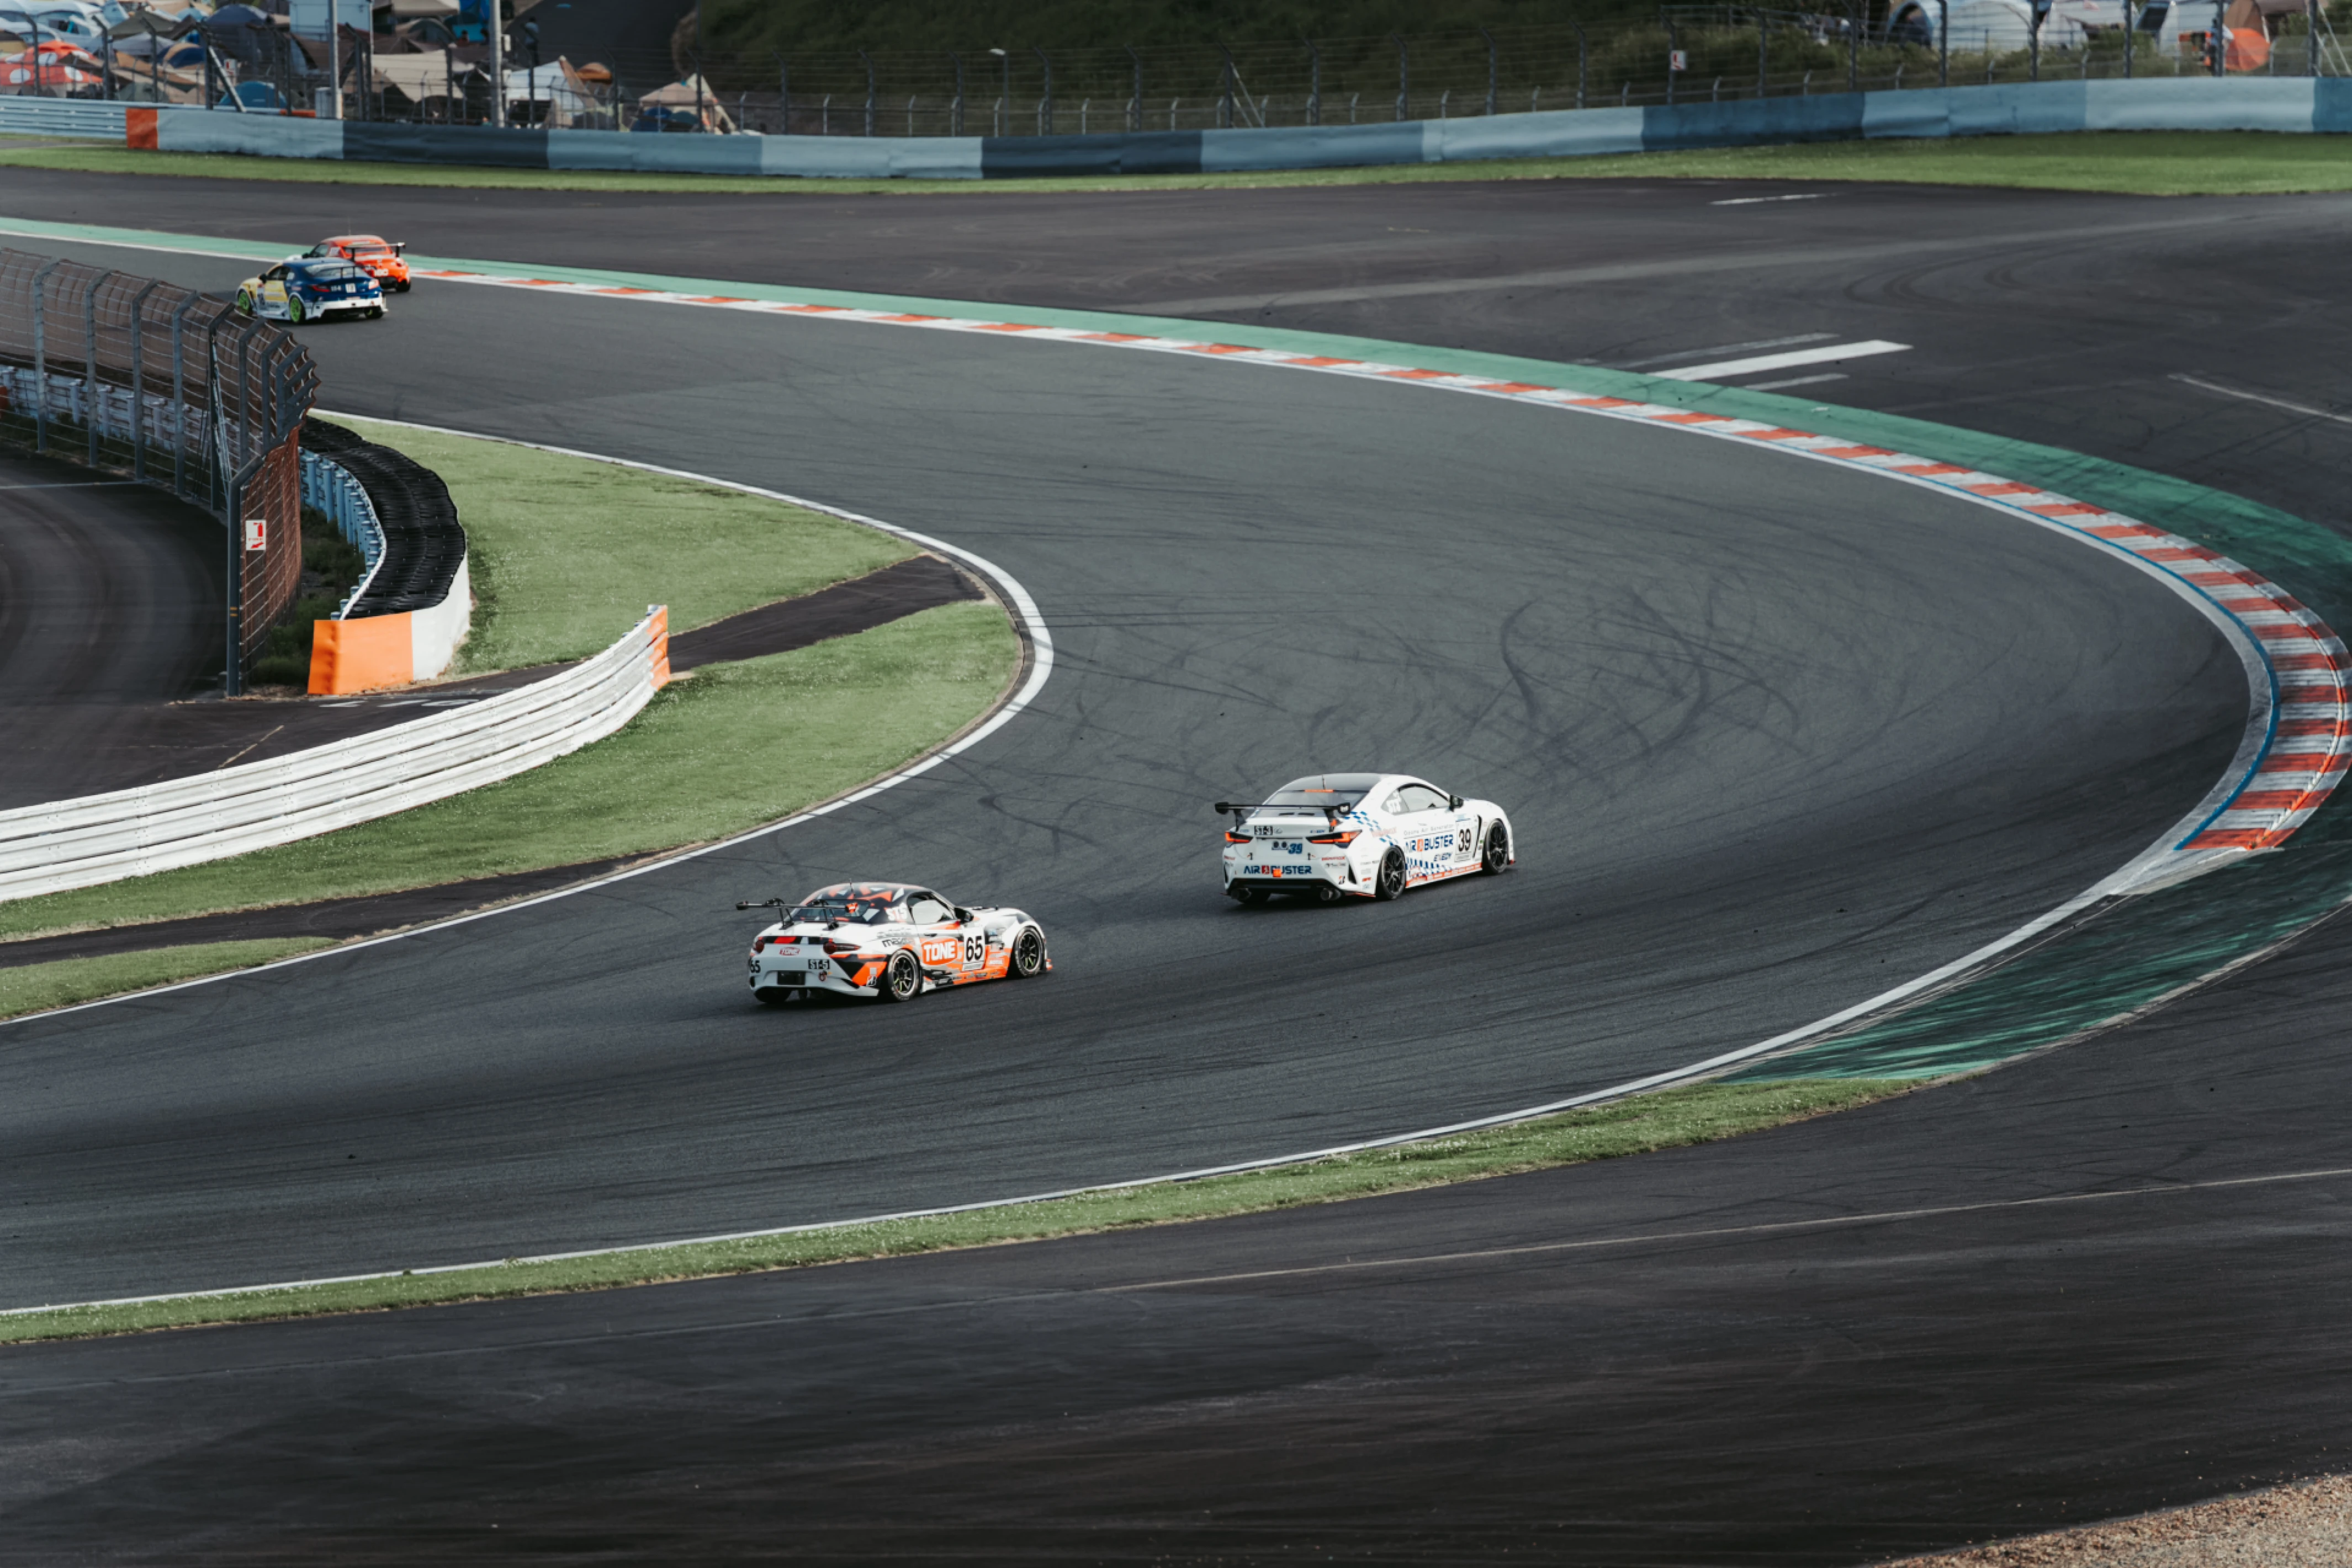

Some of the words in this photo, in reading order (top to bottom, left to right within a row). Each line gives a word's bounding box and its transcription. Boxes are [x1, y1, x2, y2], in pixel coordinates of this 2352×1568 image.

[1424, 834, 1453, 851] BUSTER
[1459, 828, 1472, 851] 39
[1288, 843, 1302, 854] 39
[1243, 865, 1260, 875] AIR
[923, 940, 956, 962] TONE
[966, 935, 983, 962] 65
[749, 960, 760, 973] 65
